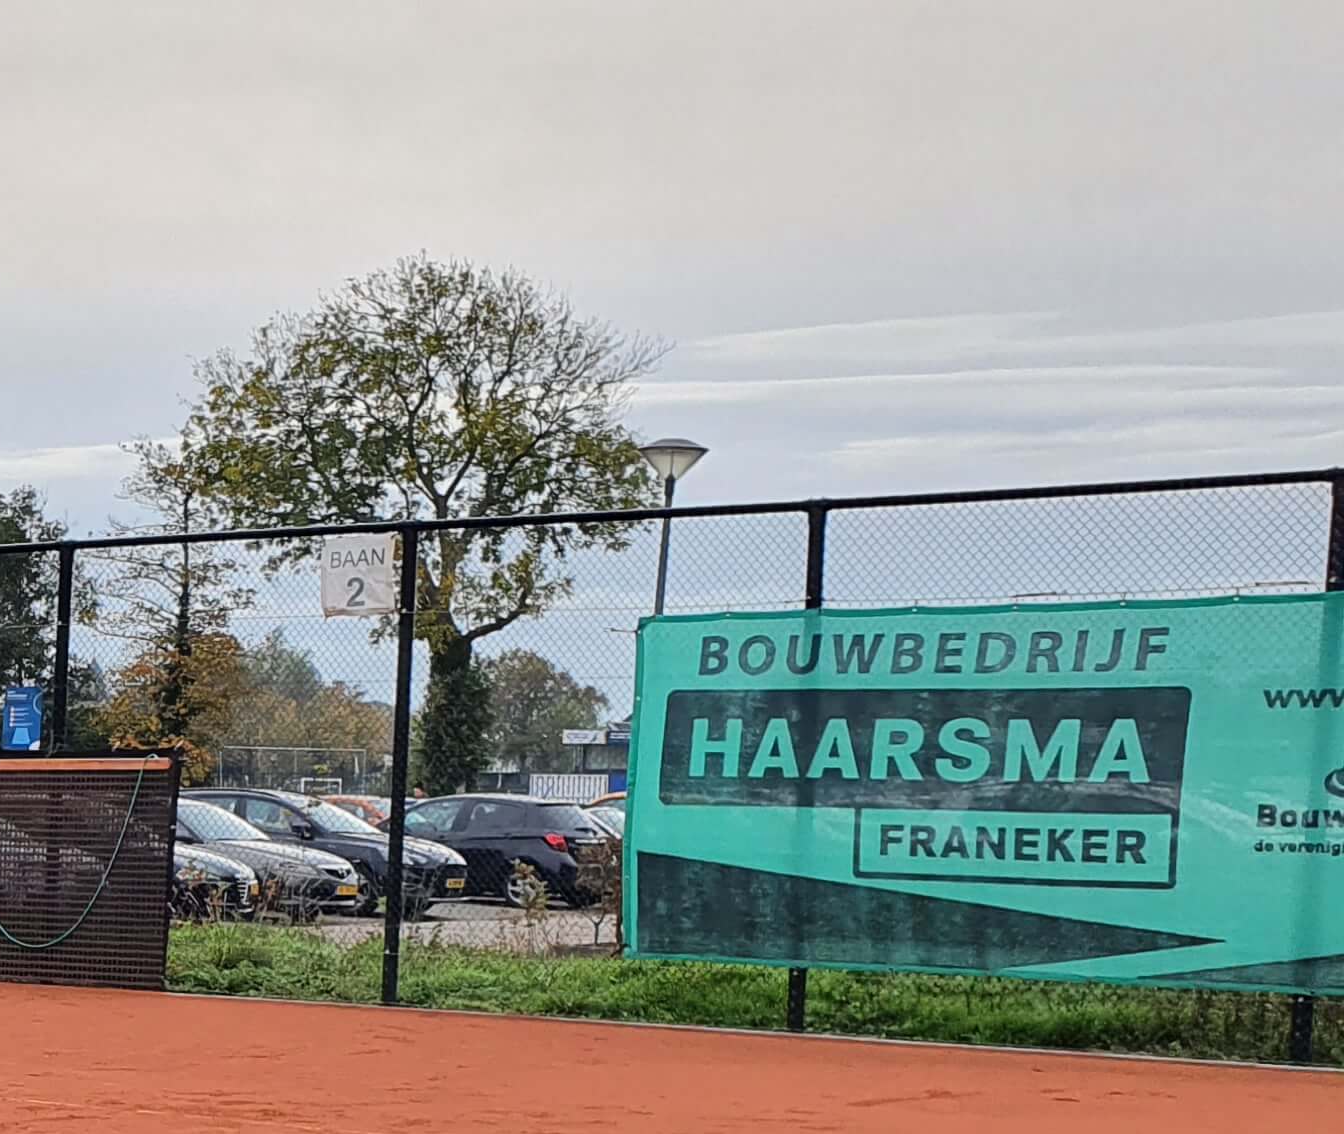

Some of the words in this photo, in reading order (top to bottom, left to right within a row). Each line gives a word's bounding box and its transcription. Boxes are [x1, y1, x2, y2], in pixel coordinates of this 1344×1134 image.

[330, 547, 386, 569] BAAN
[346, 576, 365, 608] 2
[698, 627, 1171, 676] BOUWBEDRIJF
[688, 717, 1150, 784] HAARSMA
[879, 824, 1147, 865] FRANEKER
